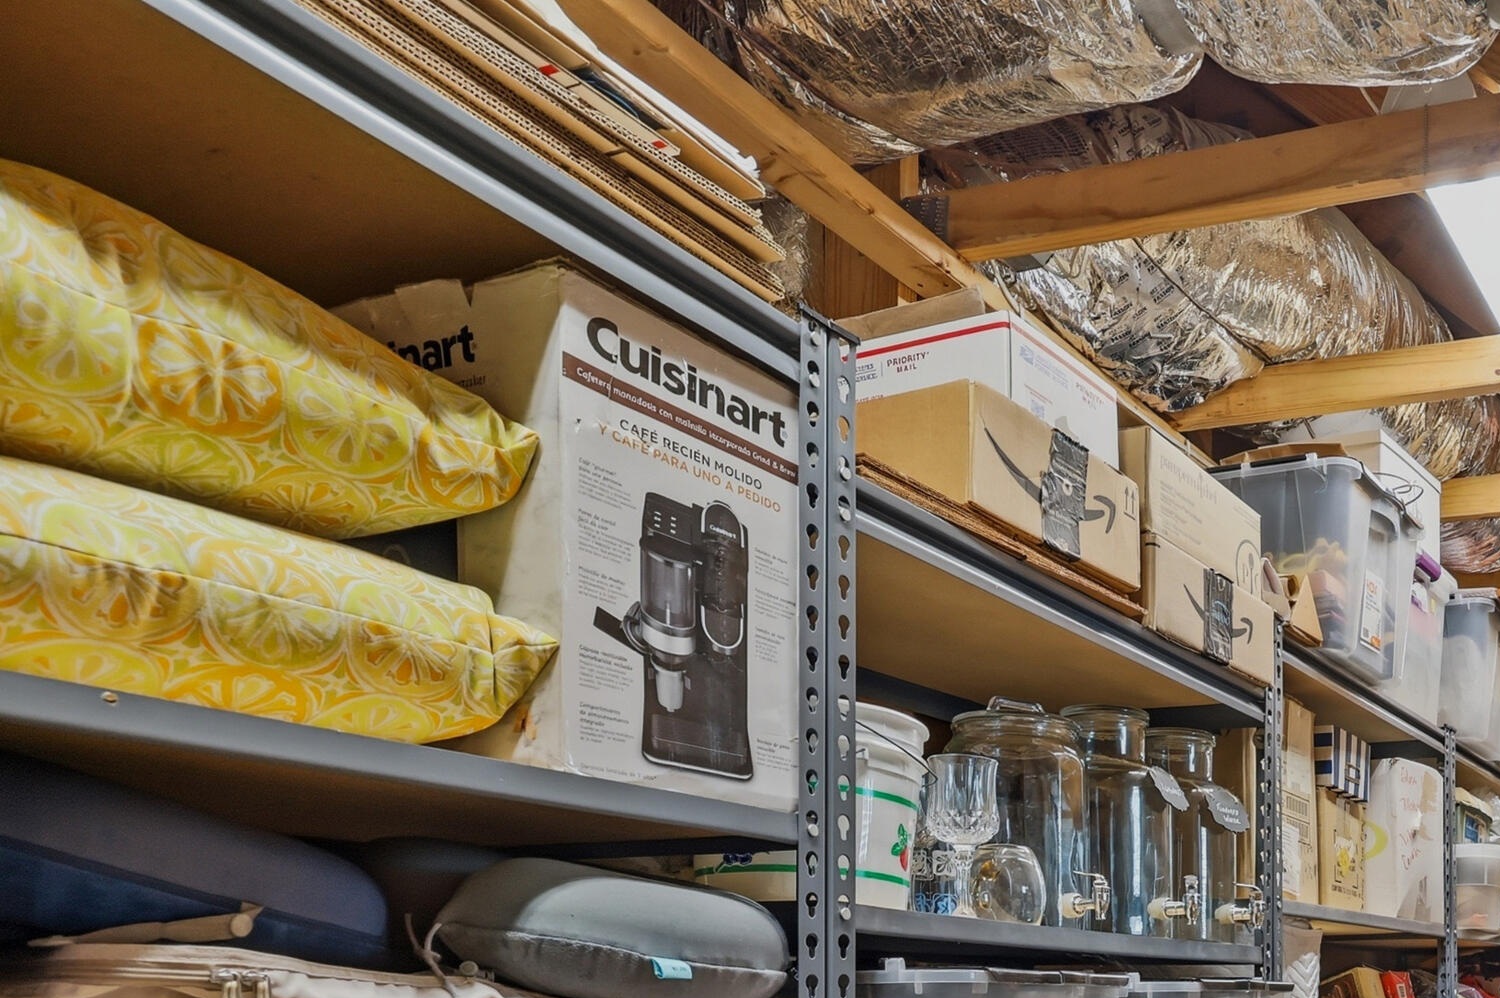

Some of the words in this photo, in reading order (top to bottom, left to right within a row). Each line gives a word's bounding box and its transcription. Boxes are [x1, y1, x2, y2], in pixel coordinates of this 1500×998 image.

[586, 316, 785, 448] Cuisinart
[886, 352, 925, 368] PRIORITY
[896, 363, 917, 374] MAIL
[599, 424, 608, 436] Y
[612, 430, 649, 456] CAFÉ
[652, 449, 689, 473] PARA
[692, 466, 722, 487] UNO
[725, 480, 735, 493] A
[737, 484, 782, 513] PEDIDO
[619, 418, 658, 444] CAFÉ
[662, 436, 711, 468] RECIÉN
[714, 460, 763, 490] MOLIDO
[659, 406, 674, 421] con
[752, 450, 771, 468] Grind
